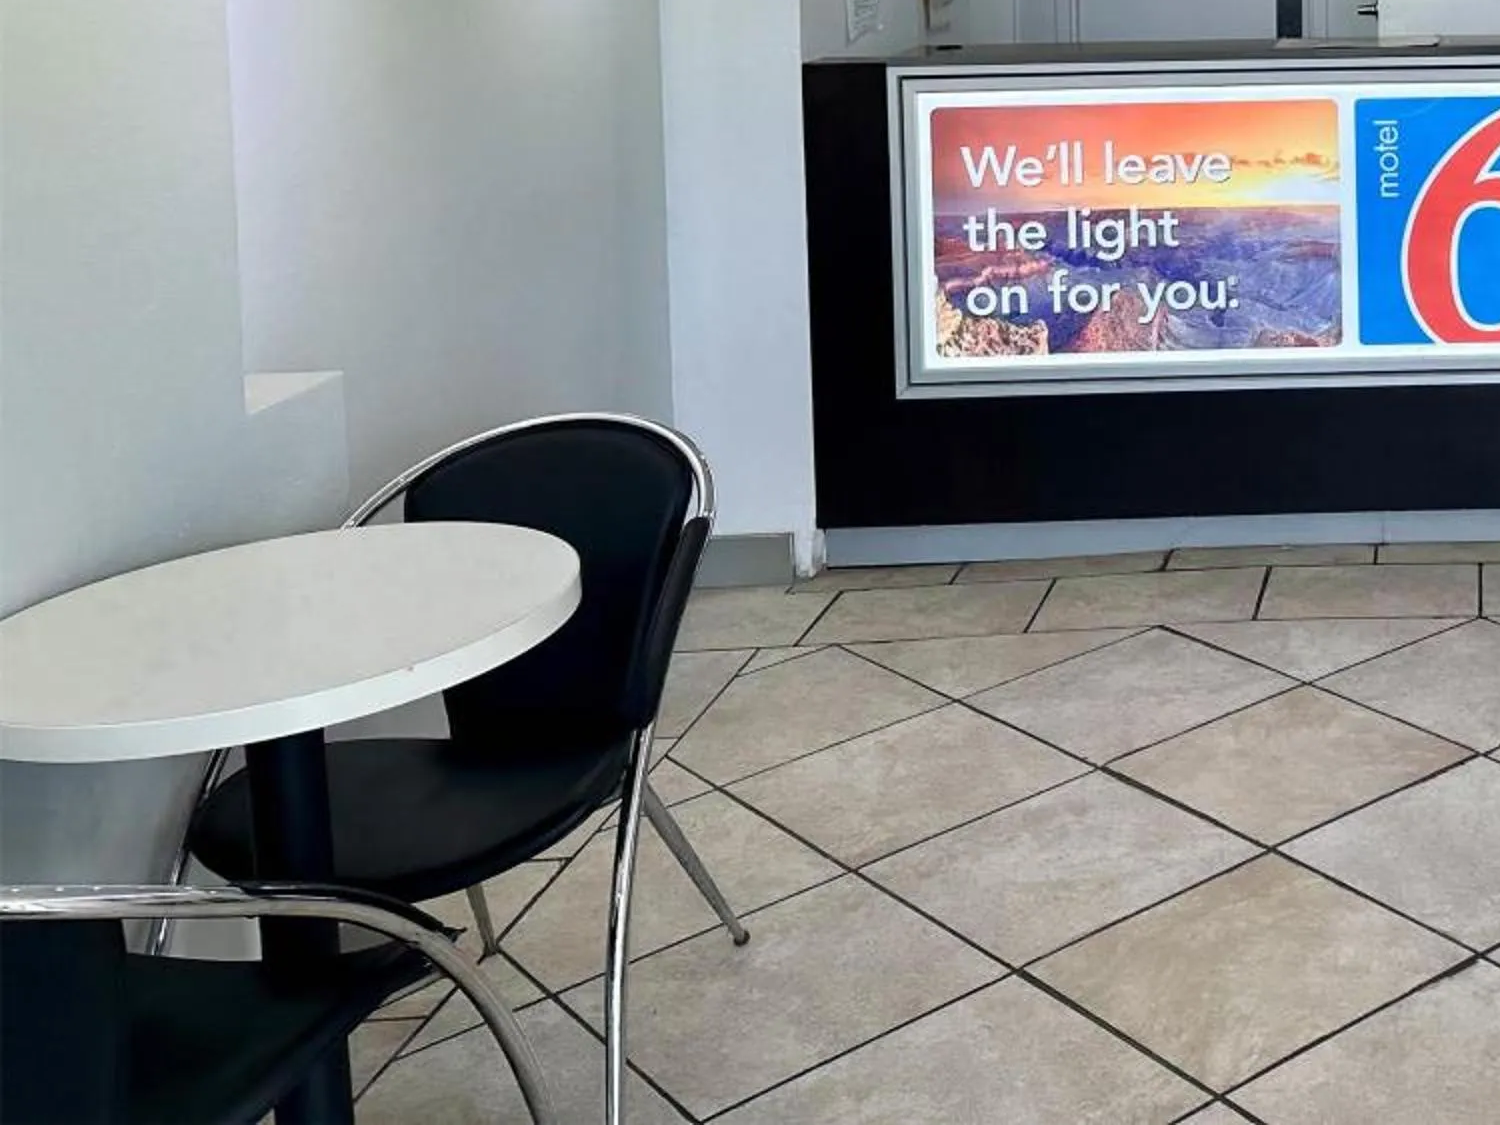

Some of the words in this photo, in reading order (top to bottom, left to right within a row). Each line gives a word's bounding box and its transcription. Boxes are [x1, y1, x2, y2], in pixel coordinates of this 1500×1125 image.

[960, 140, 1084, 188] We'll
[1104, 140, 1233, 185] leave
[1373, 119, 1400, 198] motel
[963, 207, 1048, 252] the
[1067, 204, 1181, 262] light
[966, 283, 1030, 317] on
[1047, 269, 1122, 315] for
